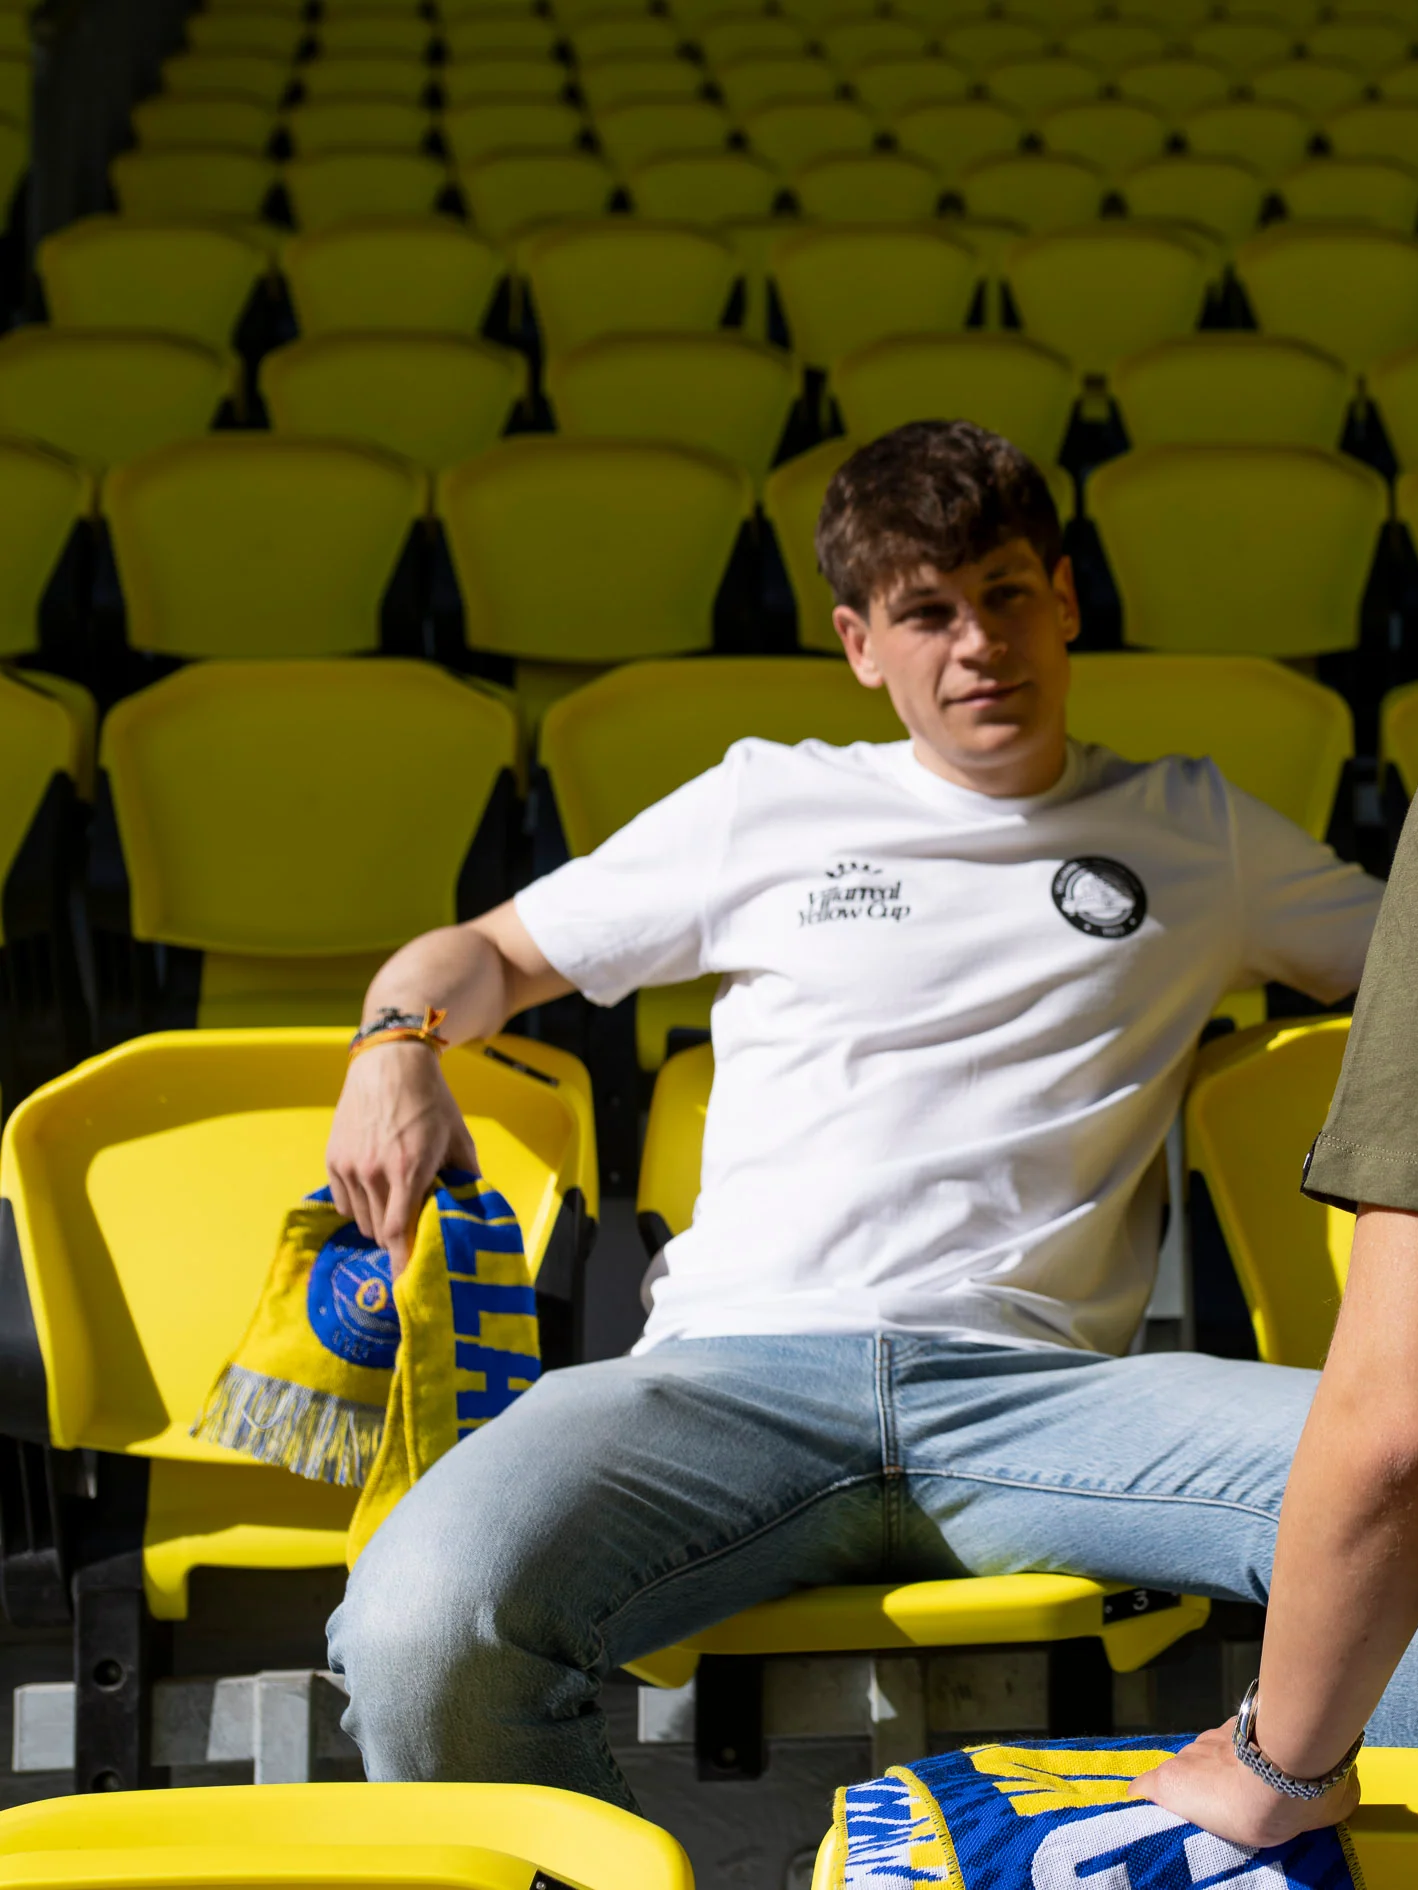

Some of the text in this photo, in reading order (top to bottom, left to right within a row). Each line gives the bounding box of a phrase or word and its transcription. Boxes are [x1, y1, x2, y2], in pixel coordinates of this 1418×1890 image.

[808, 880, 901, 904] Villarreal
[798, 899, 910, 927] Yellow Cup
[1132, 1590, 1149, 1611] 3
